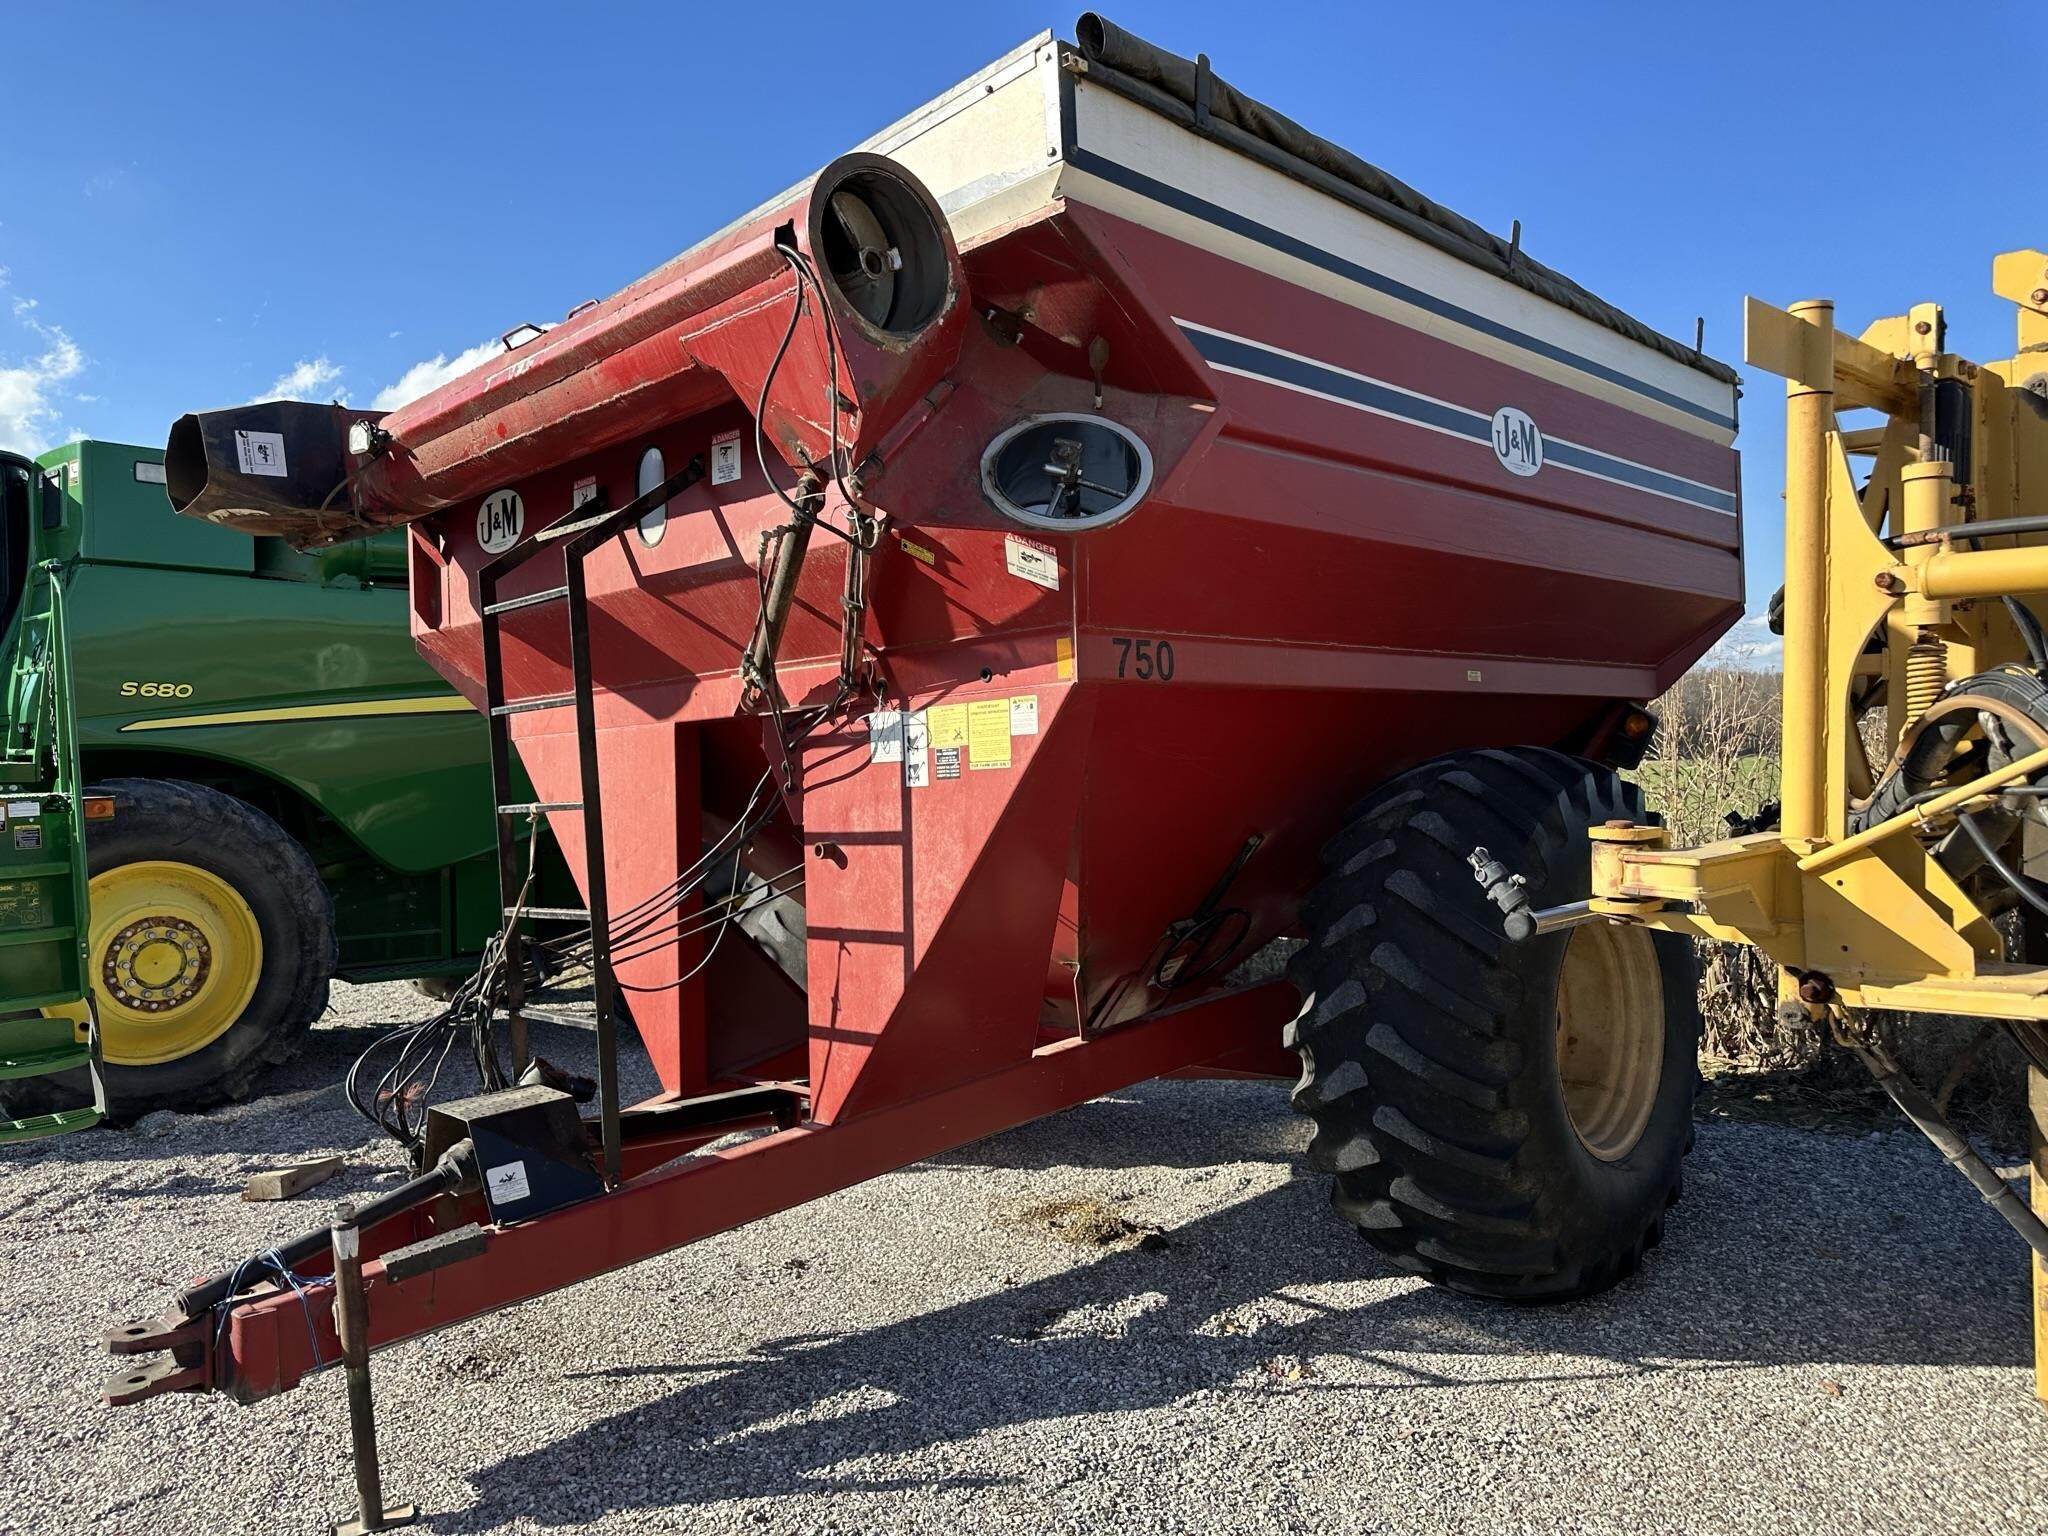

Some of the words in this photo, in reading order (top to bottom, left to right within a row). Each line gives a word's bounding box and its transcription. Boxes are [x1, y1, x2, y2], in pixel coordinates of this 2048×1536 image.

[717, 430, 740, 442] DANGER
[1496, 414, 1538, 467] J&M
[480, 494, 519, 545] J&M
[1014, 534, 1057, 556] DANGER
[1112, 637, 1175, 681] 750
[120, 681, 194, 698] S680
